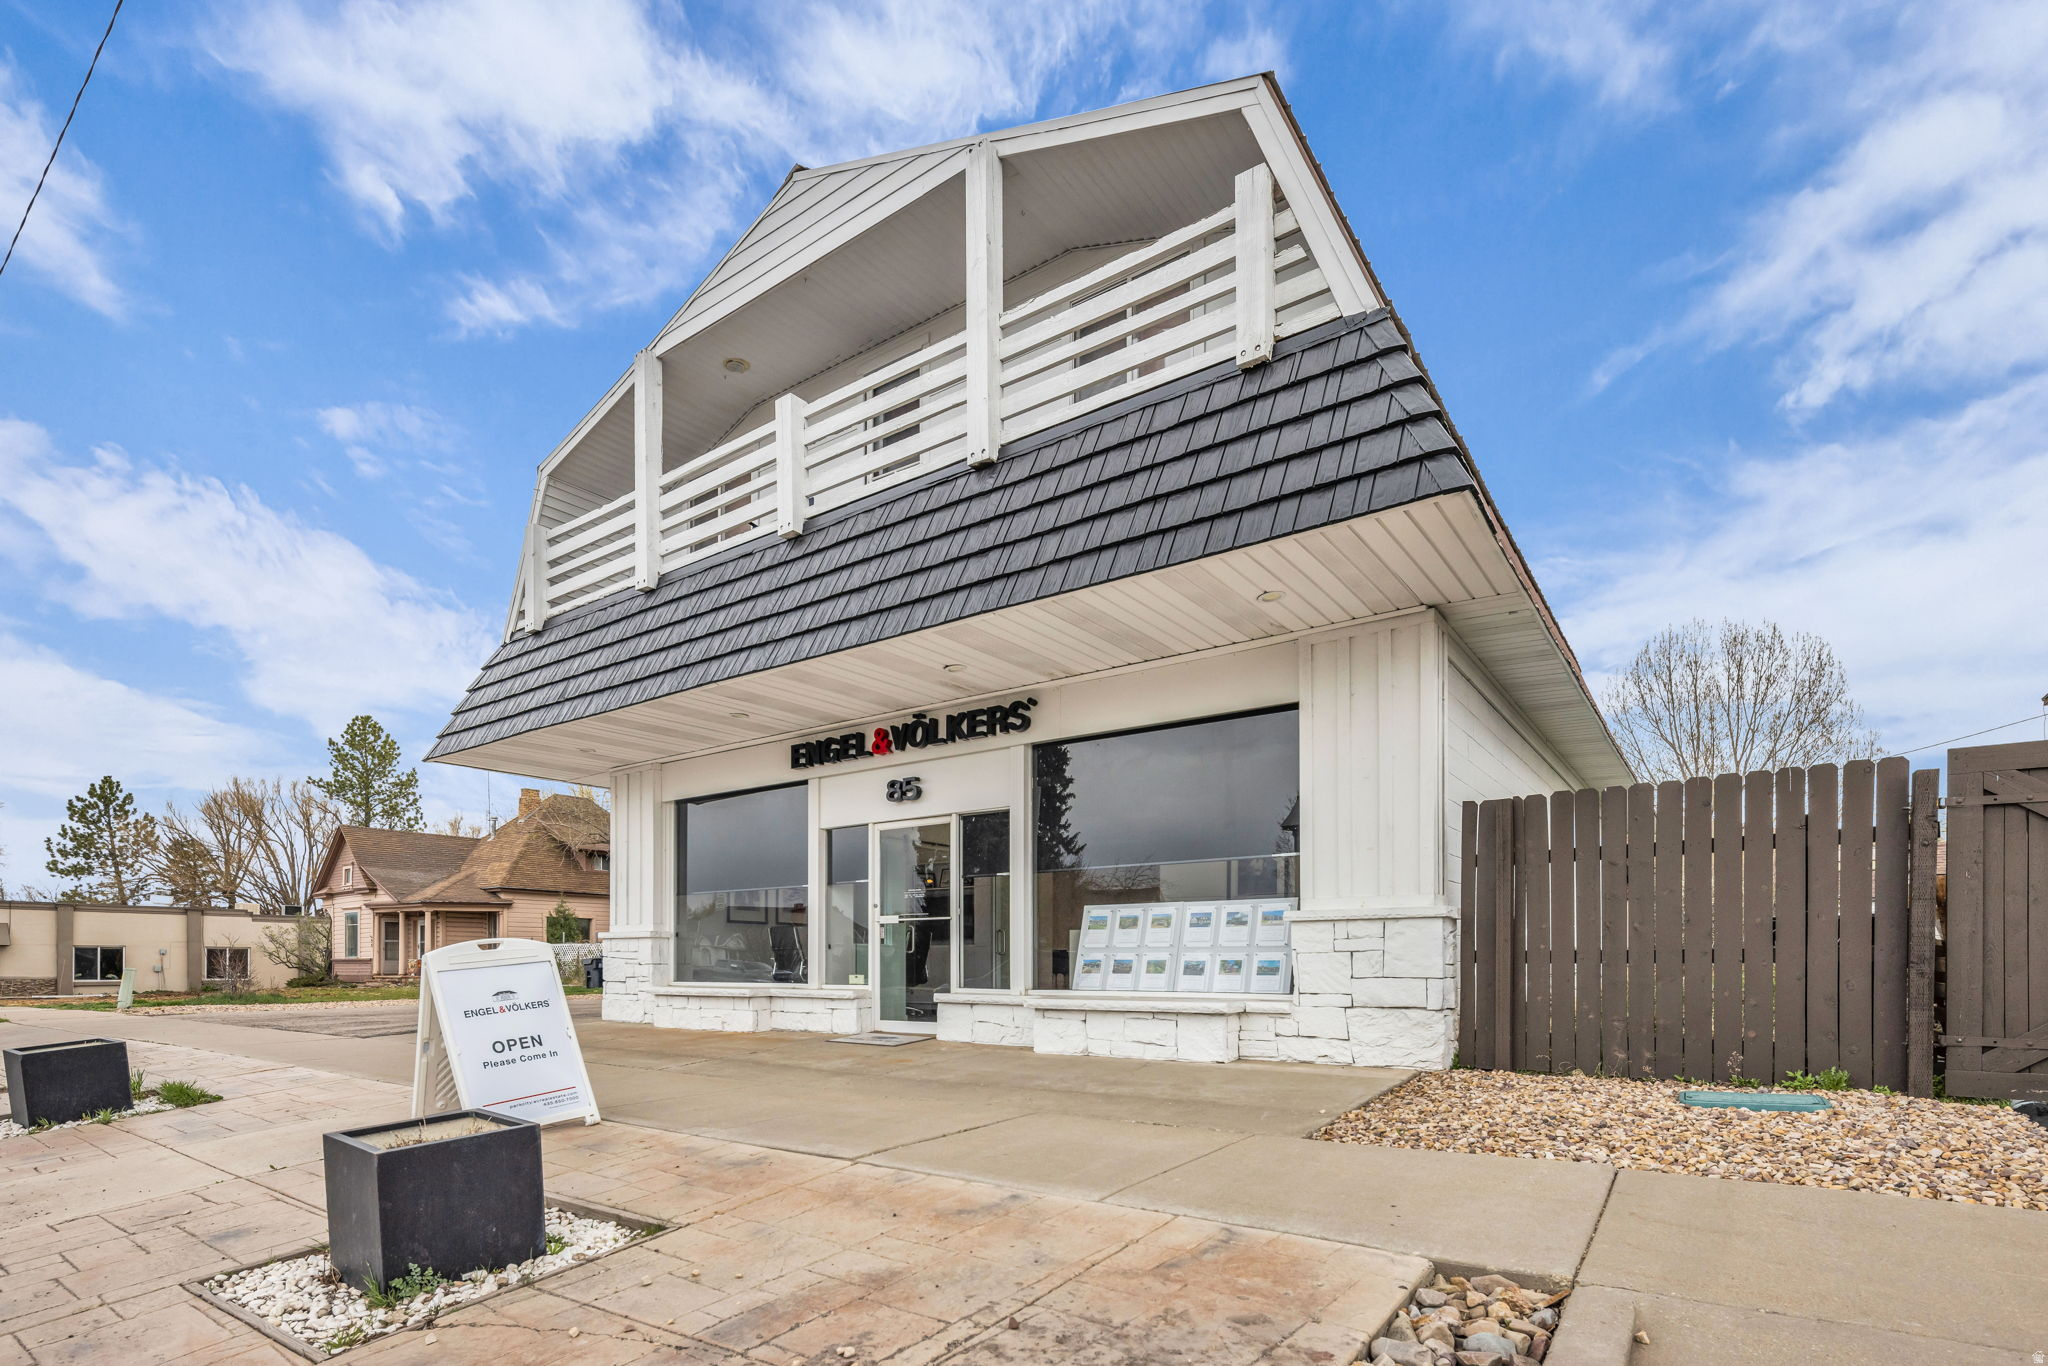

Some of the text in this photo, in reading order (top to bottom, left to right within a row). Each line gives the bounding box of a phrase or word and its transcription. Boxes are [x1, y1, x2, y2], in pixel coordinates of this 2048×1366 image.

[885, 776, 923, 803] 85
[492, 1034, 544, 1054] OPEN
[482, 1050, 559, 1070] Please Come In
